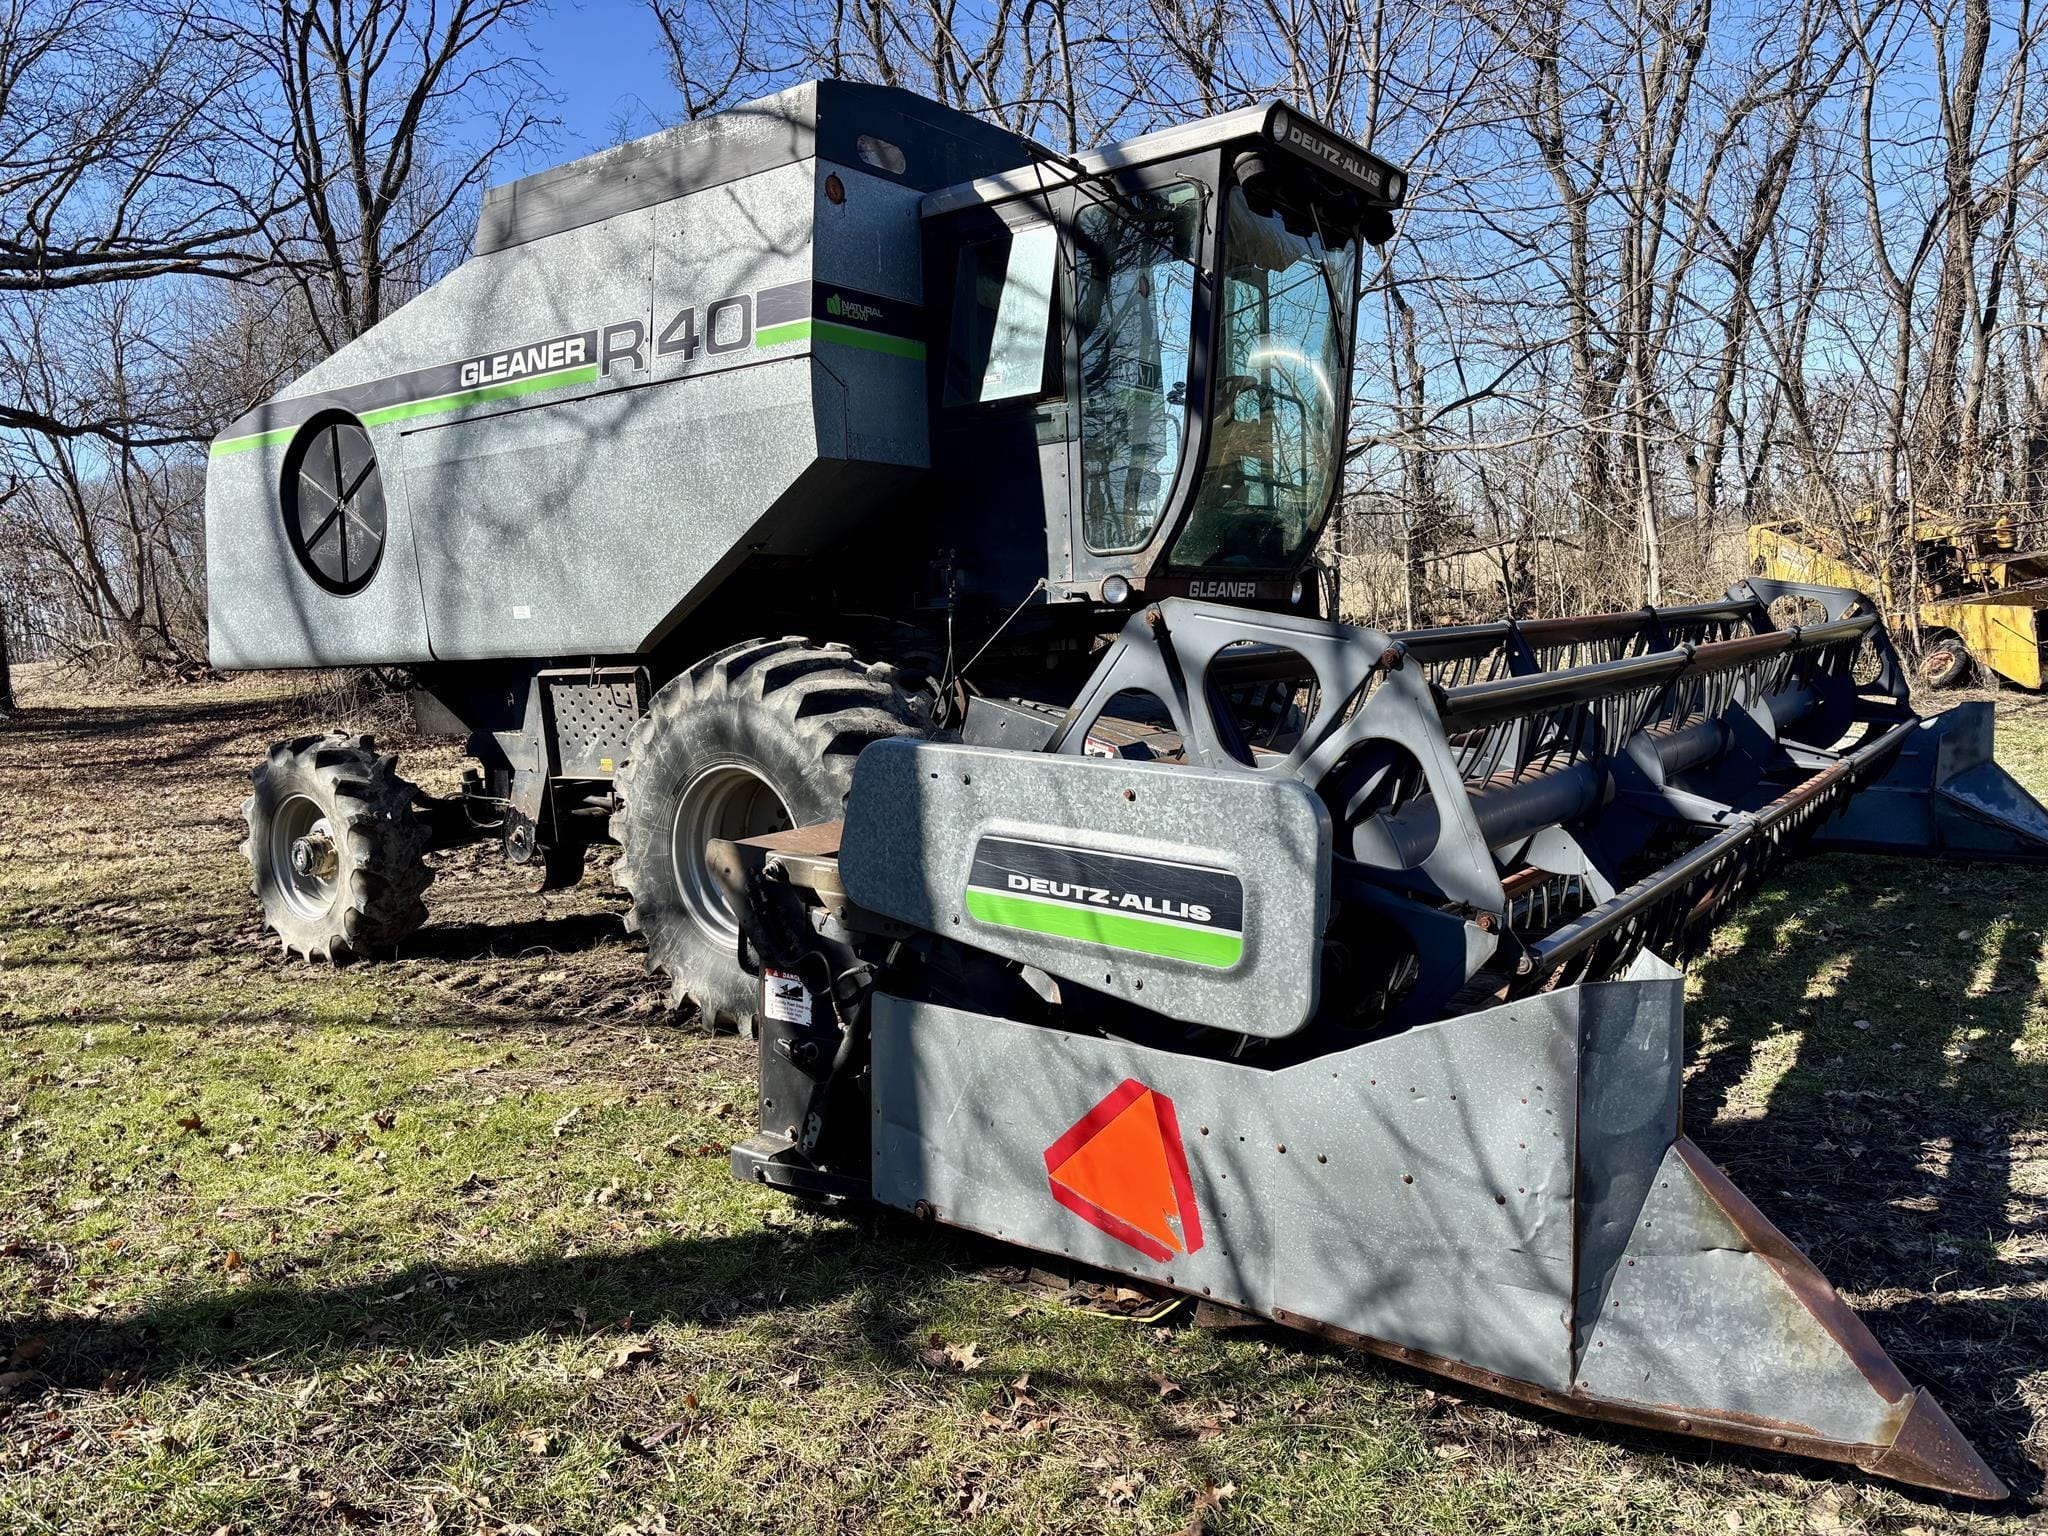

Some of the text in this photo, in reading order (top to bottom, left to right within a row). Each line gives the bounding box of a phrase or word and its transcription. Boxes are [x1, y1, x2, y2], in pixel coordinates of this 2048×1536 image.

[1289, 126, 1381, 188] DEUTZ-ALLIS
[841, 300, 884, 318] NATURAL
[841, 308, 868, 322] FLOW
[460, 337, 586, 388] GLEANER
[1189, 581, 1256, 598] GLEANER
[1008, 873, 1213, 922] DEUTZ-ALLIS
